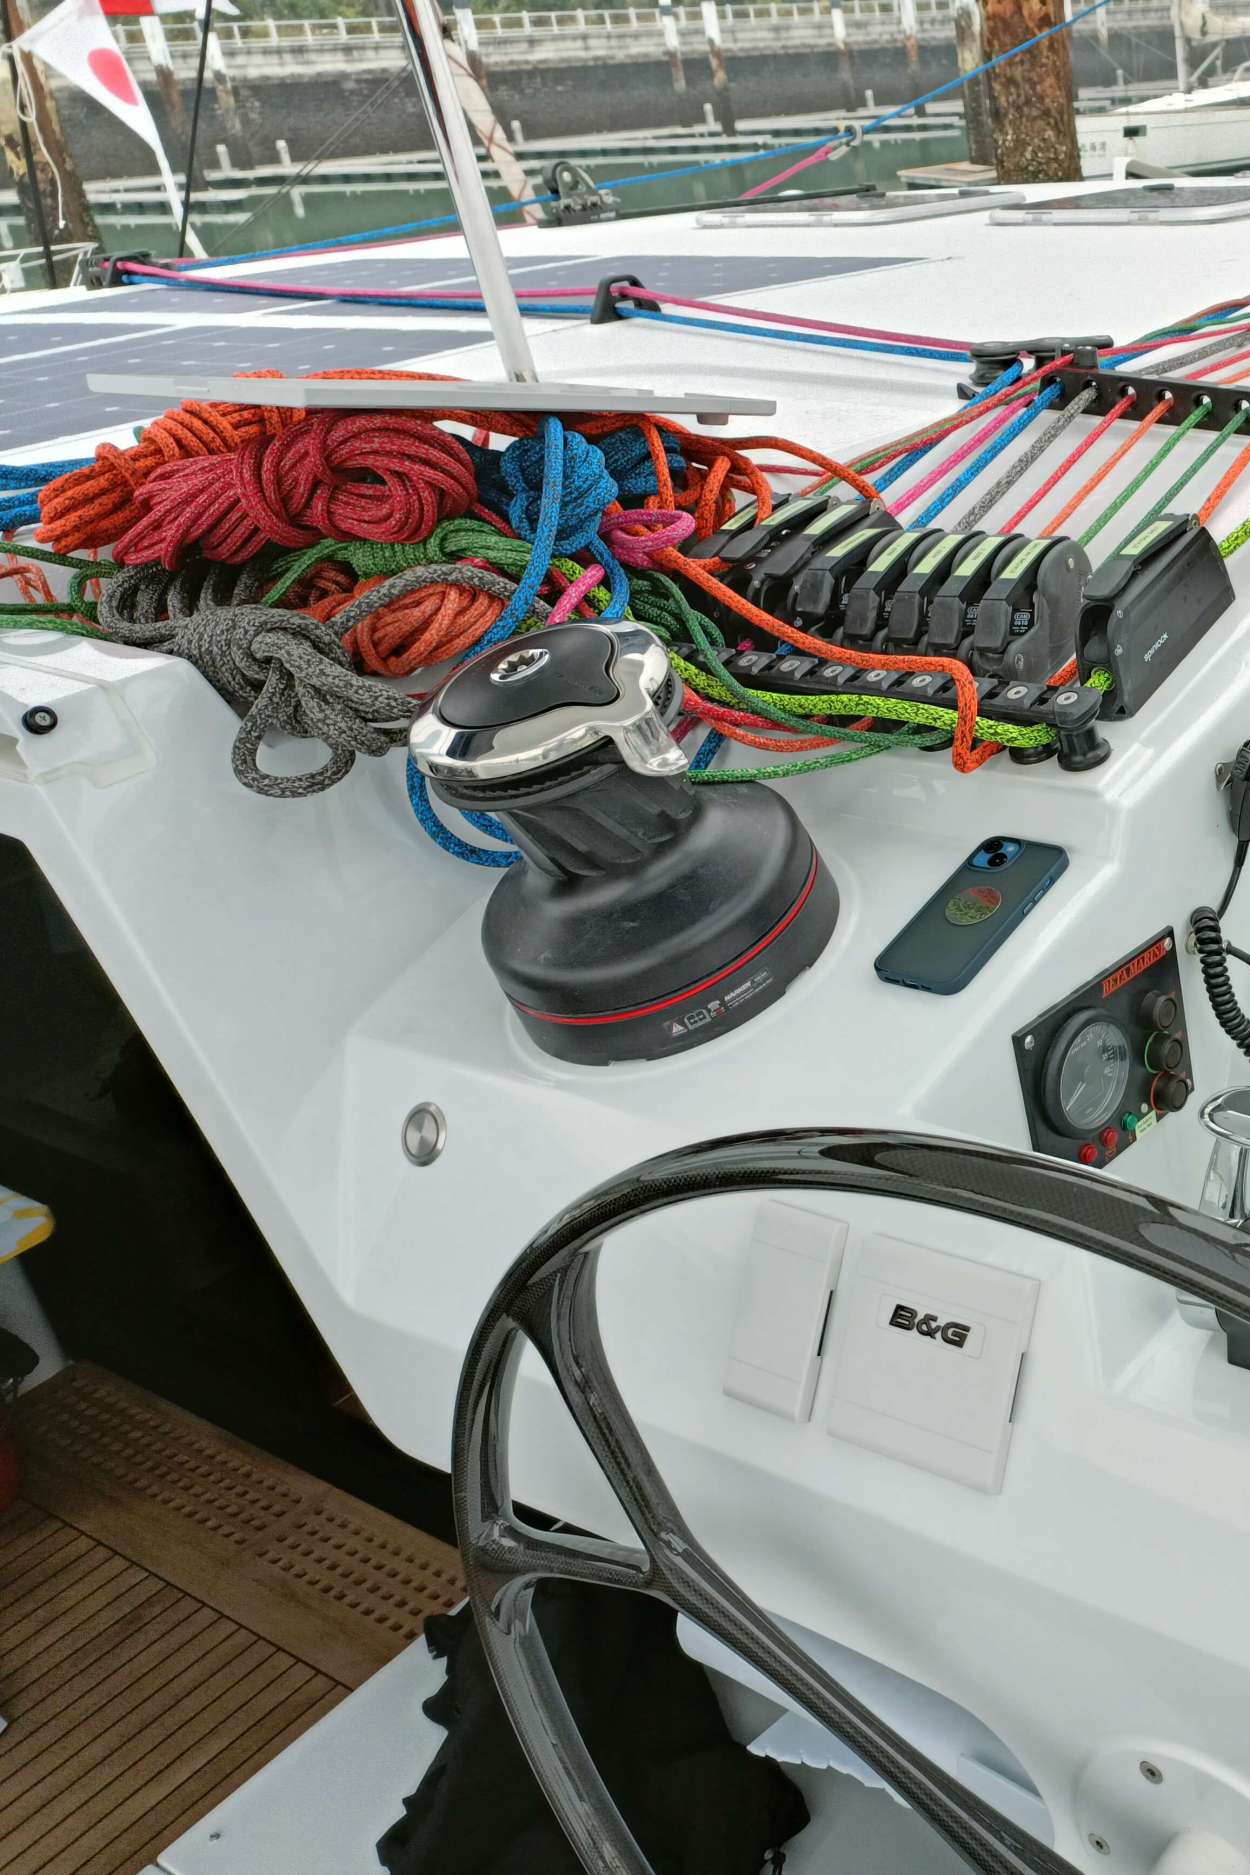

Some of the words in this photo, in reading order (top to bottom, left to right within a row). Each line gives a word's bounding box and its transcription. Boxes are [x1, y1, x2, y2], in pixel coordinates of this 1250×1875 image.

[1144, 631, 1169, 662] spinlock
[1103, 966, 1130, 998] BETA
[889, 1303, 972, 1349] B&G
